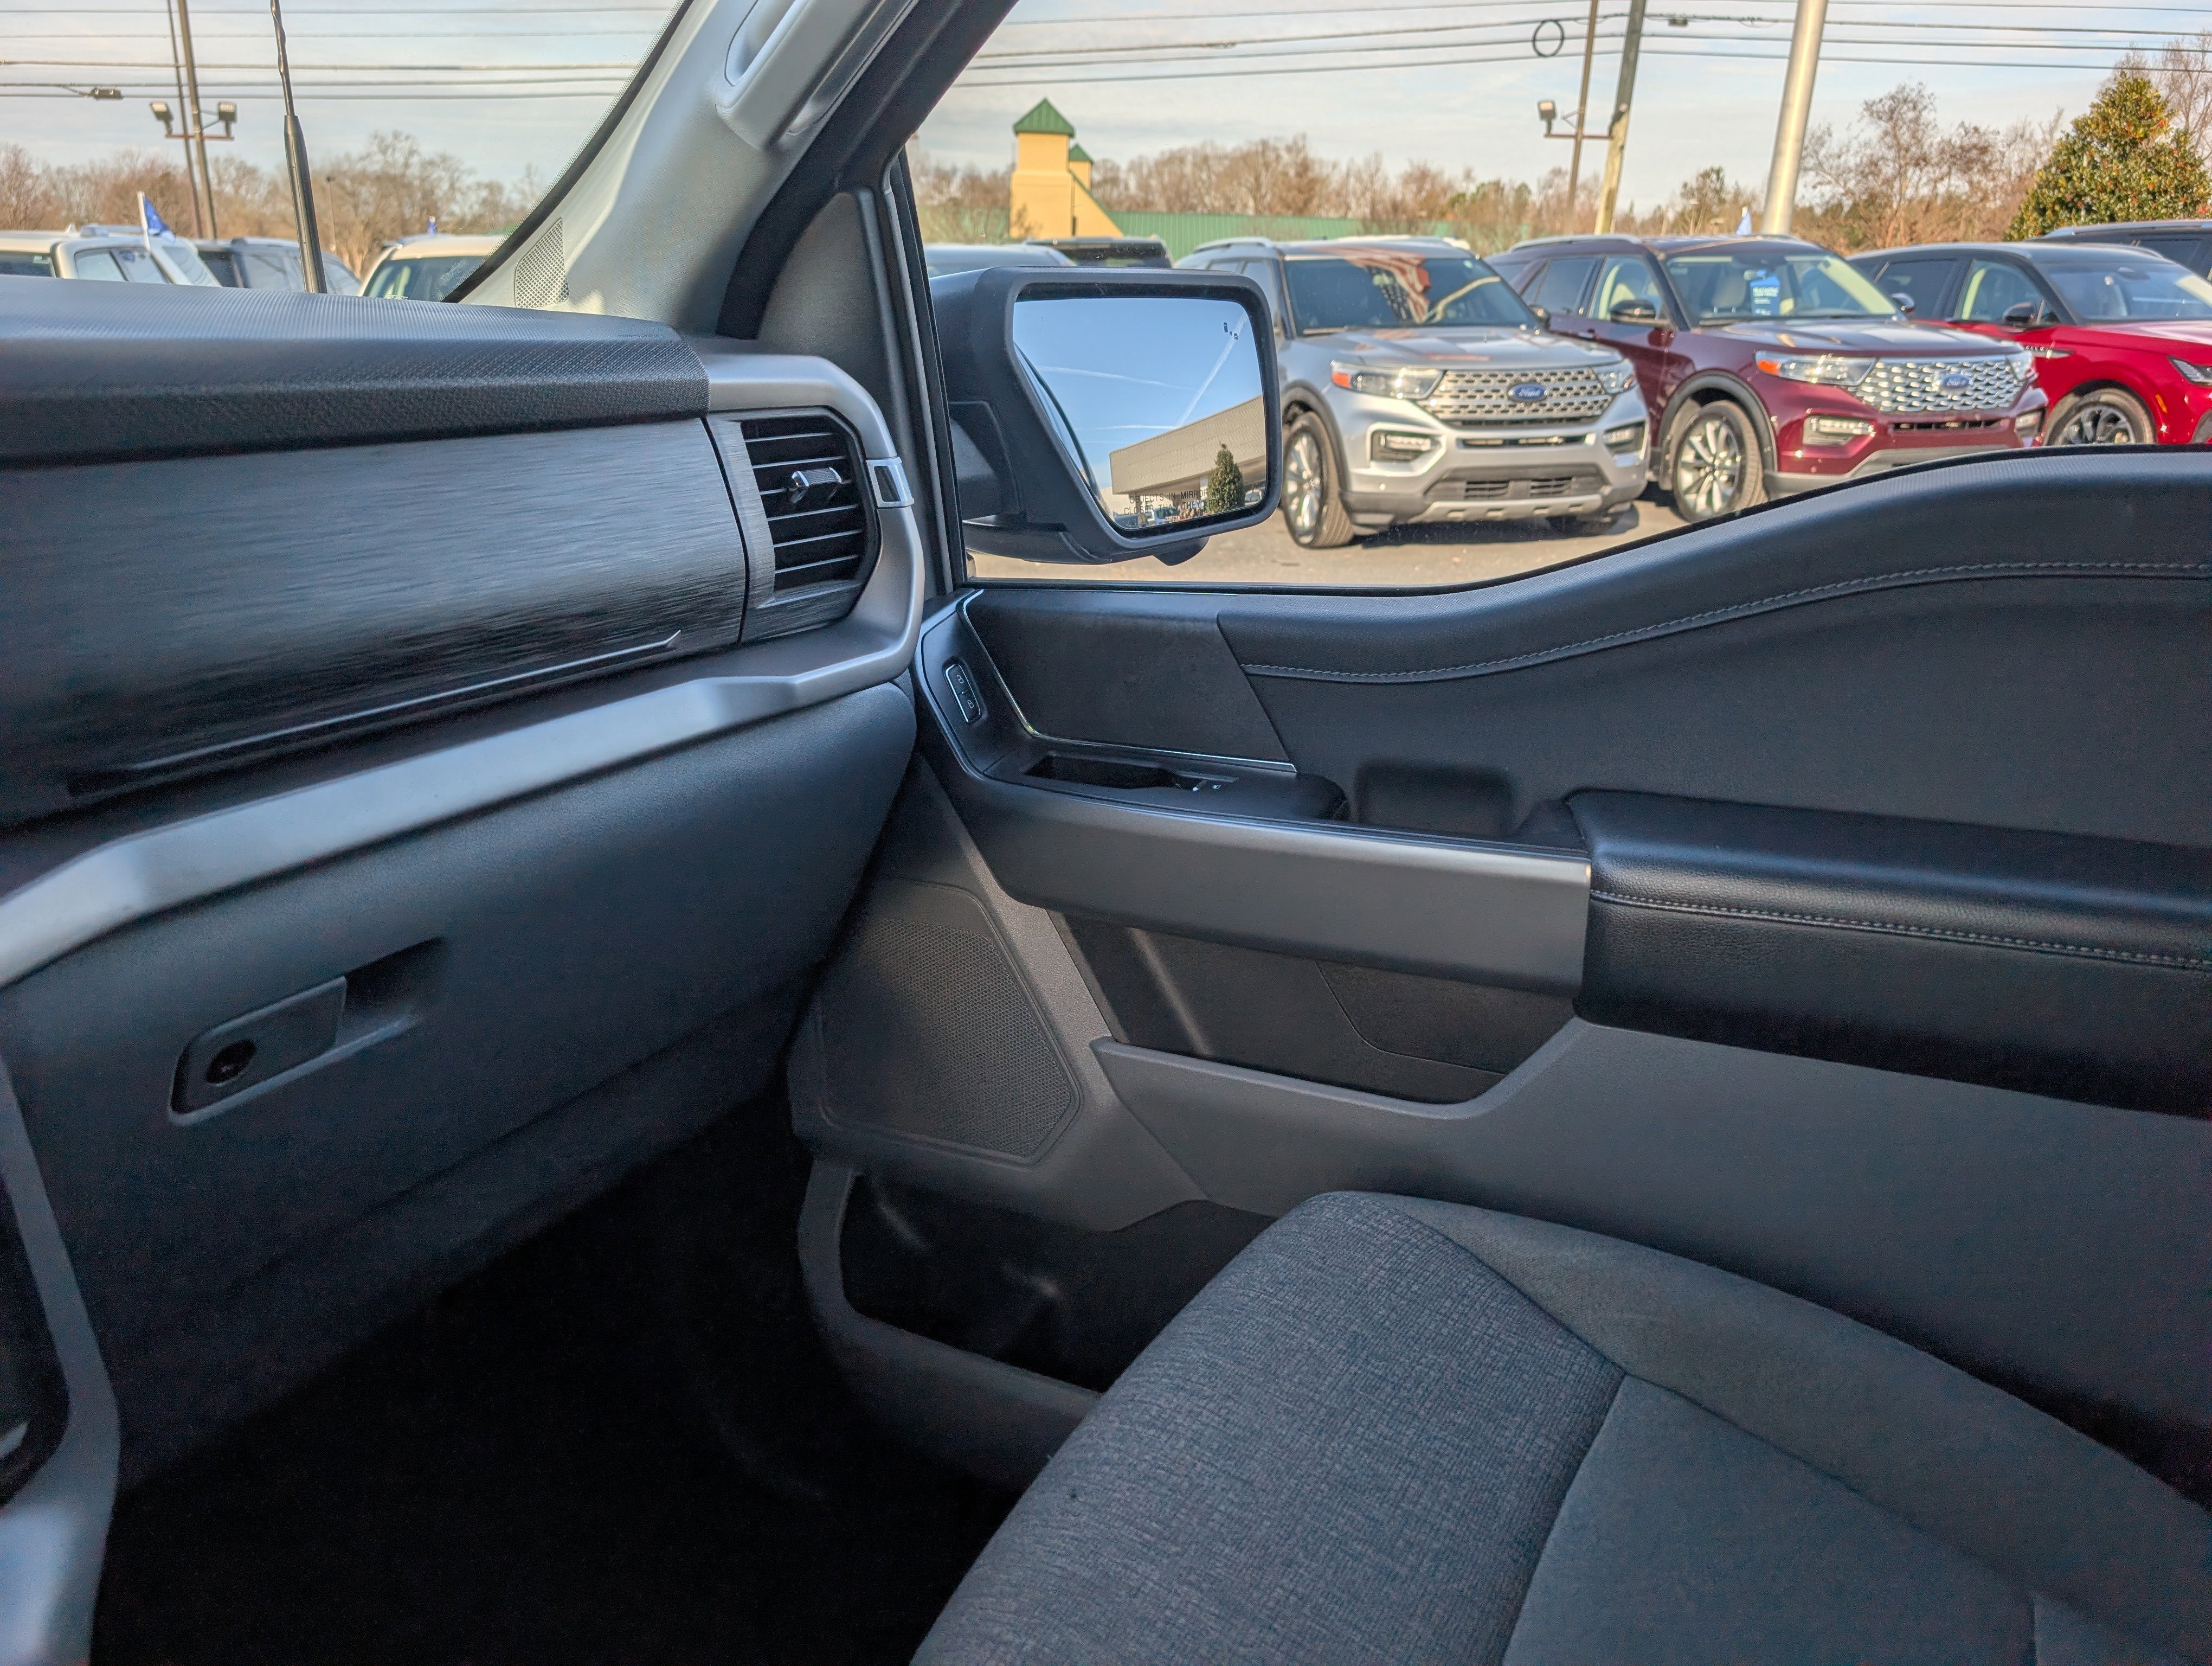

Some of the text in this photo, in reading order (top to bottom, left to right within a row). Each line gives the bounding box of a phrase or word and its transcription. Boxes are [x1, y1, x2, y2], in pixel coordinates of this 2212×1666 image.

[1129, 487, 1225, 504] OBJECTS IN MIRROR ARE
[1124, 497, 1231, 515] CLOSER THAN THEY APPEAR
